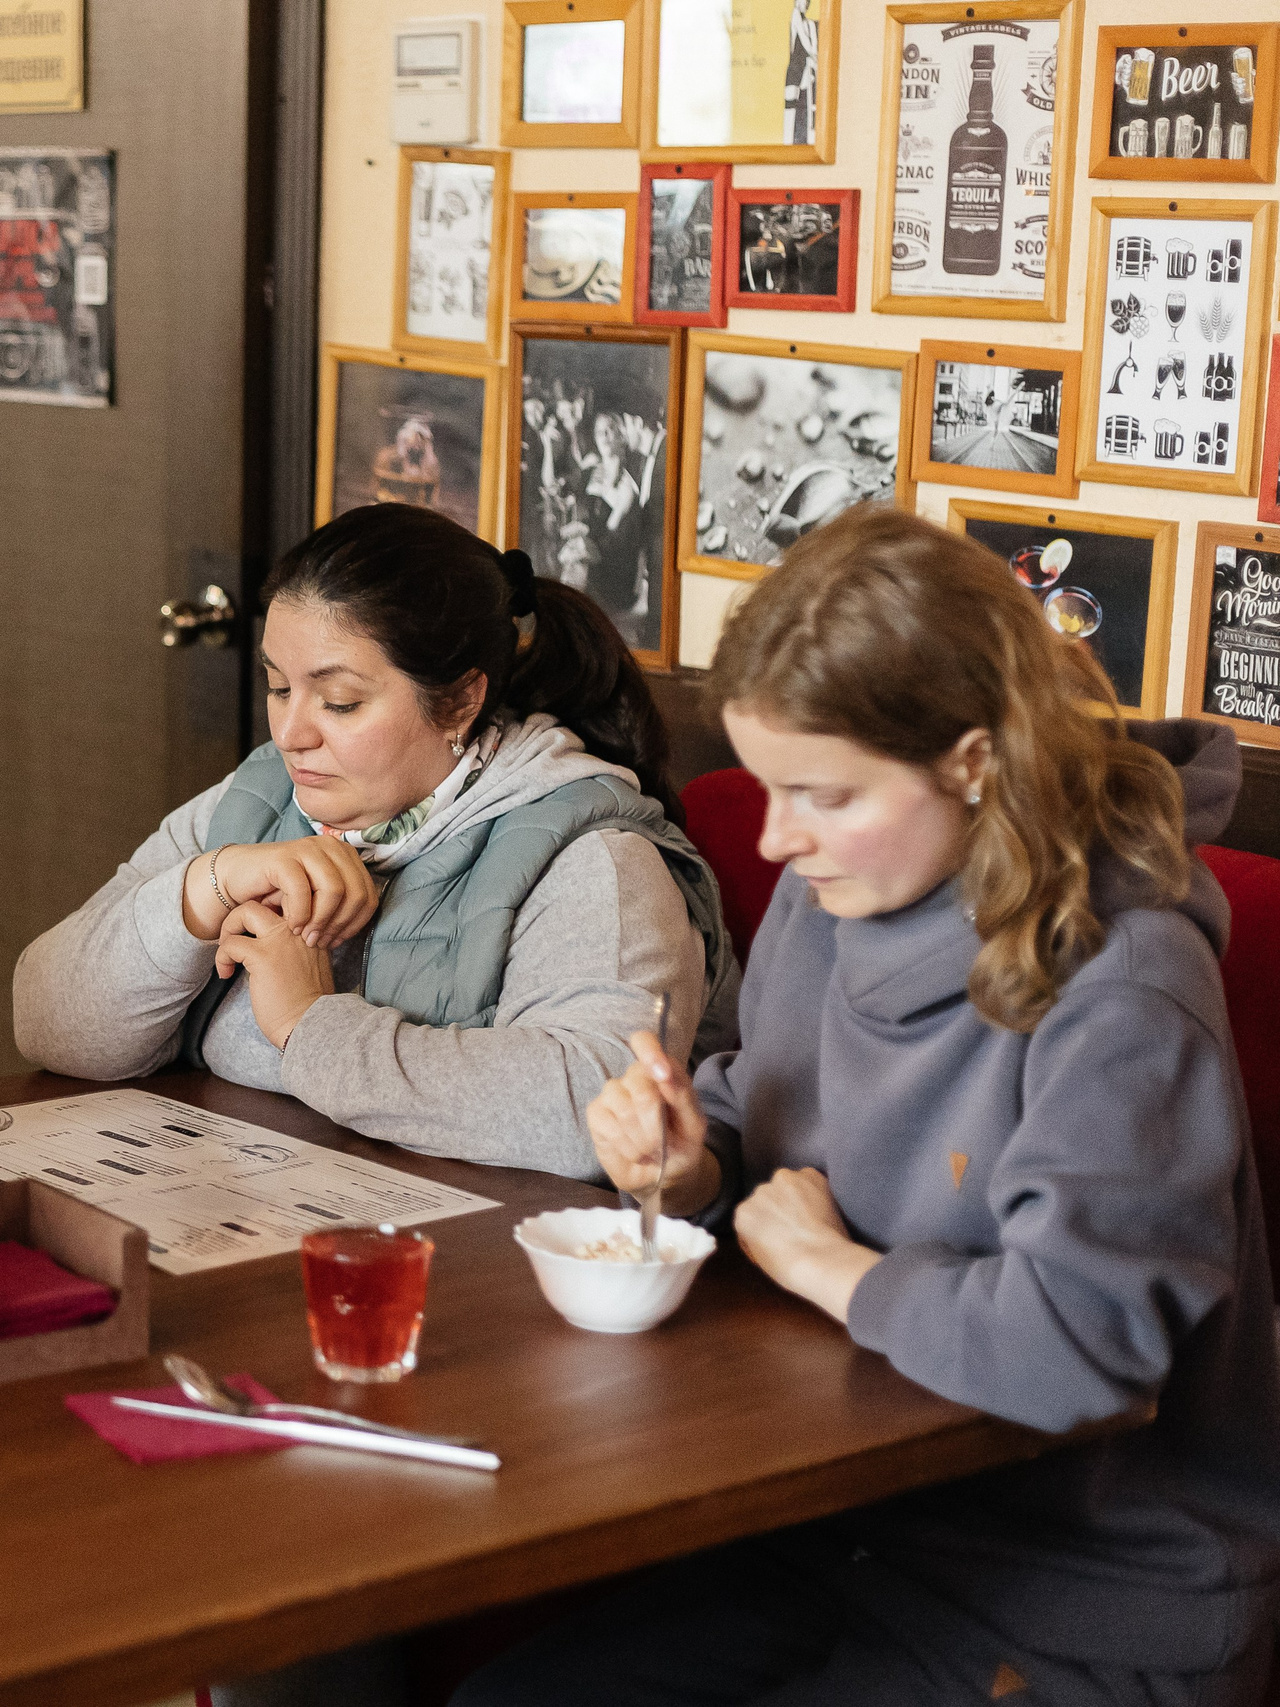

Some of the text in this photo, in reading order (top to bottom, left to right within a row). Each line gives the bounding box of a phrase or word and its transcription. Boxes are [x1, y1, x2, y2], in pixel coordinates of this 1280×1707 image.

[950, 24, 1022, 36] VINTAGE LABELS
[1161, 57, 1221, 101] Beer
[901, 84, 930, 99] IN
[1032, 98, 1053, 110] OLD
[951, 187, 1001, 203] TEQUILA
[1014, 239, 1047, 256] SCO
[1240, 683, 1256, 699] with
